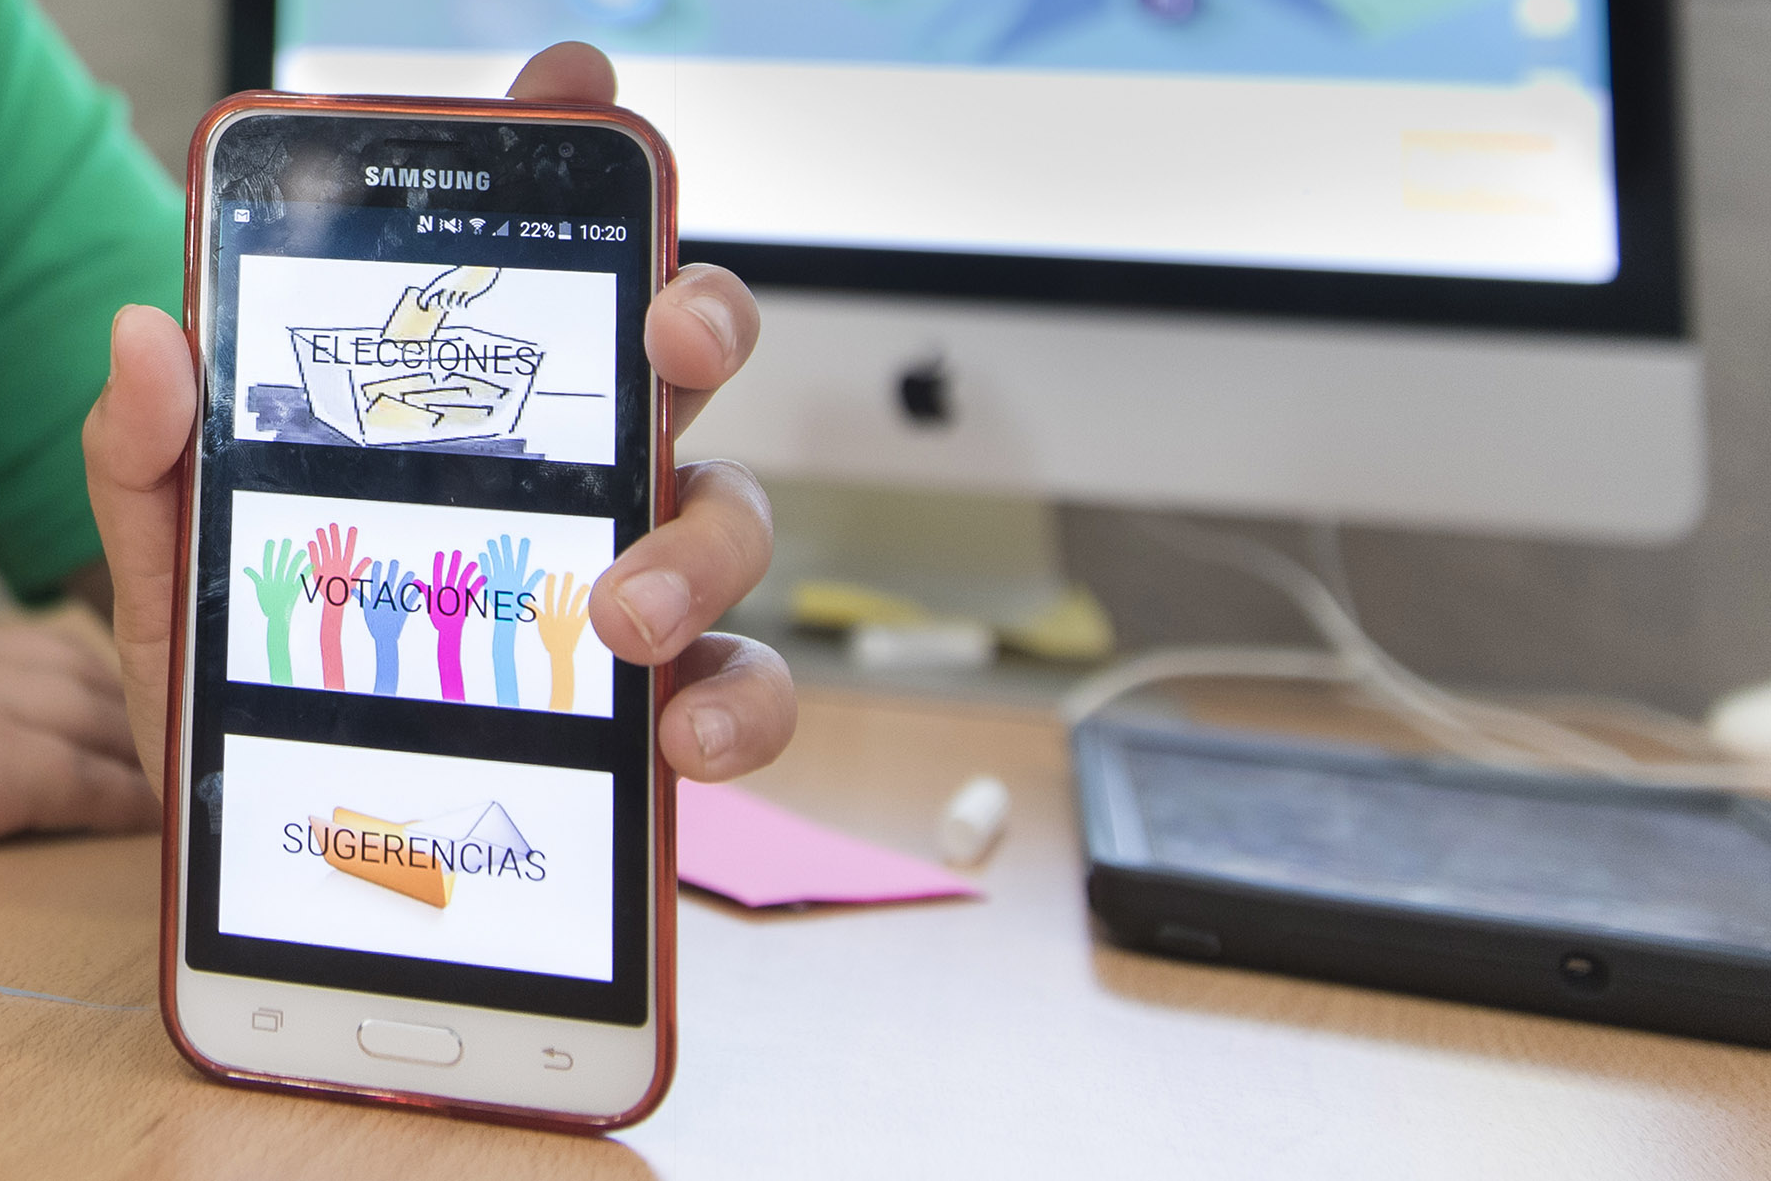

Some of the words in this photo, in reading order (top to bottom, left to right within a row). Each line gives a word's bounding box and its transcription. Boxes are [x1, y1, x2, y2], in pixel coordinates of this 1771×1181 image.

[364, 166, 491, 191] SAMSUNG
[519, 221, 556, 239] 22%
[579, 224, 627, 242] 10:20
[312, 335, 537, 376] ELECCIONES
[300, 573, 538, 623] VOTACIONES
[282, 822, 547, 882] SUGERENCIAS
